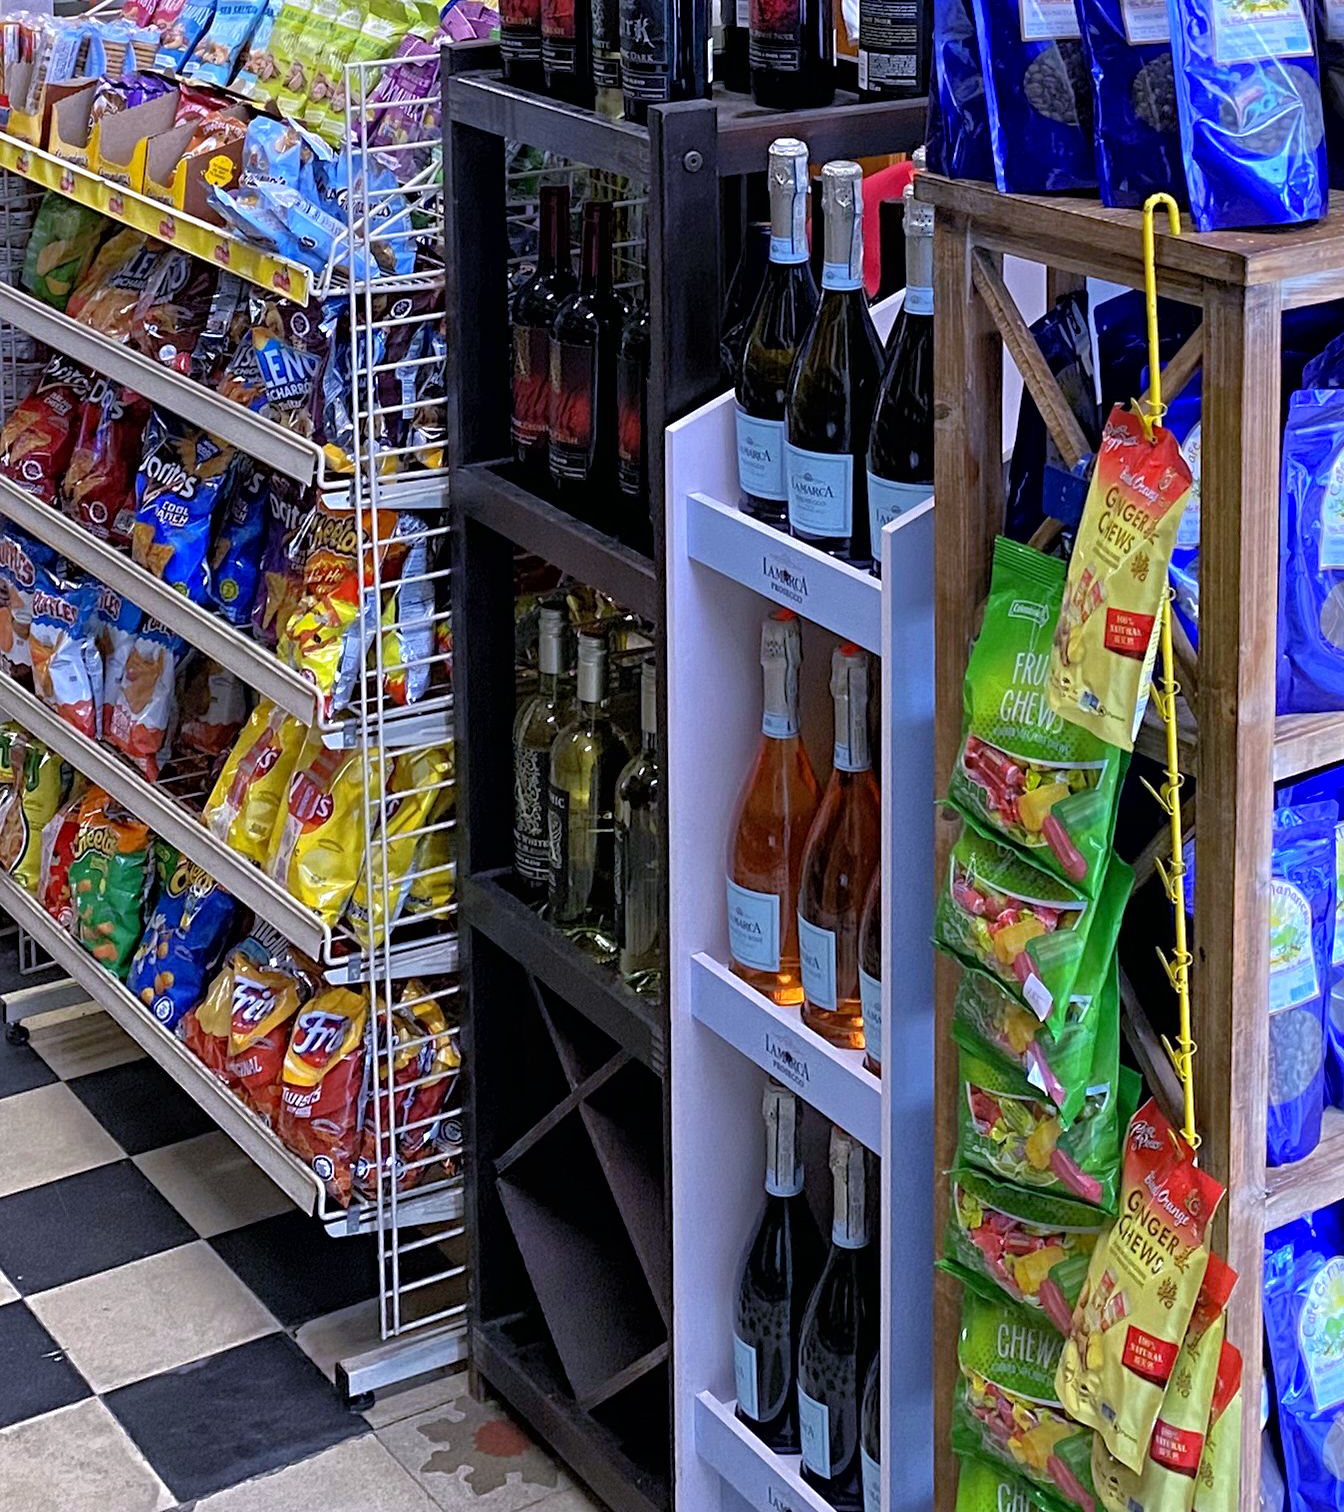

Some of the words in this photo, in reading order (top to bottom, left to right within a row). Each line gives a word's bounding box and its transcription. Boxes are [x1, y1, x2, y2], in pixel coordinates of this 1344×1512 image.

[162, 501, 189, 515] COOL
[1098, 511, 1135, 554] CHEWS
[762, 556, 809, 596] LAMARCA
[771, 581, 803, 604] PROSECCO
[1012, 652, 1050, 686] FRU
[293, 1010, 349, 1054] Fri
[765, 1033, 810, 1081] LAMARCA
[772, 1061, 805, 1088] PROSECCO
[1118, 1217, 1164, 1274] CHEWS
[997, 1325, 1054, 1367] CHEW
[1129, 1343, 1163, 1364] NATURAL
